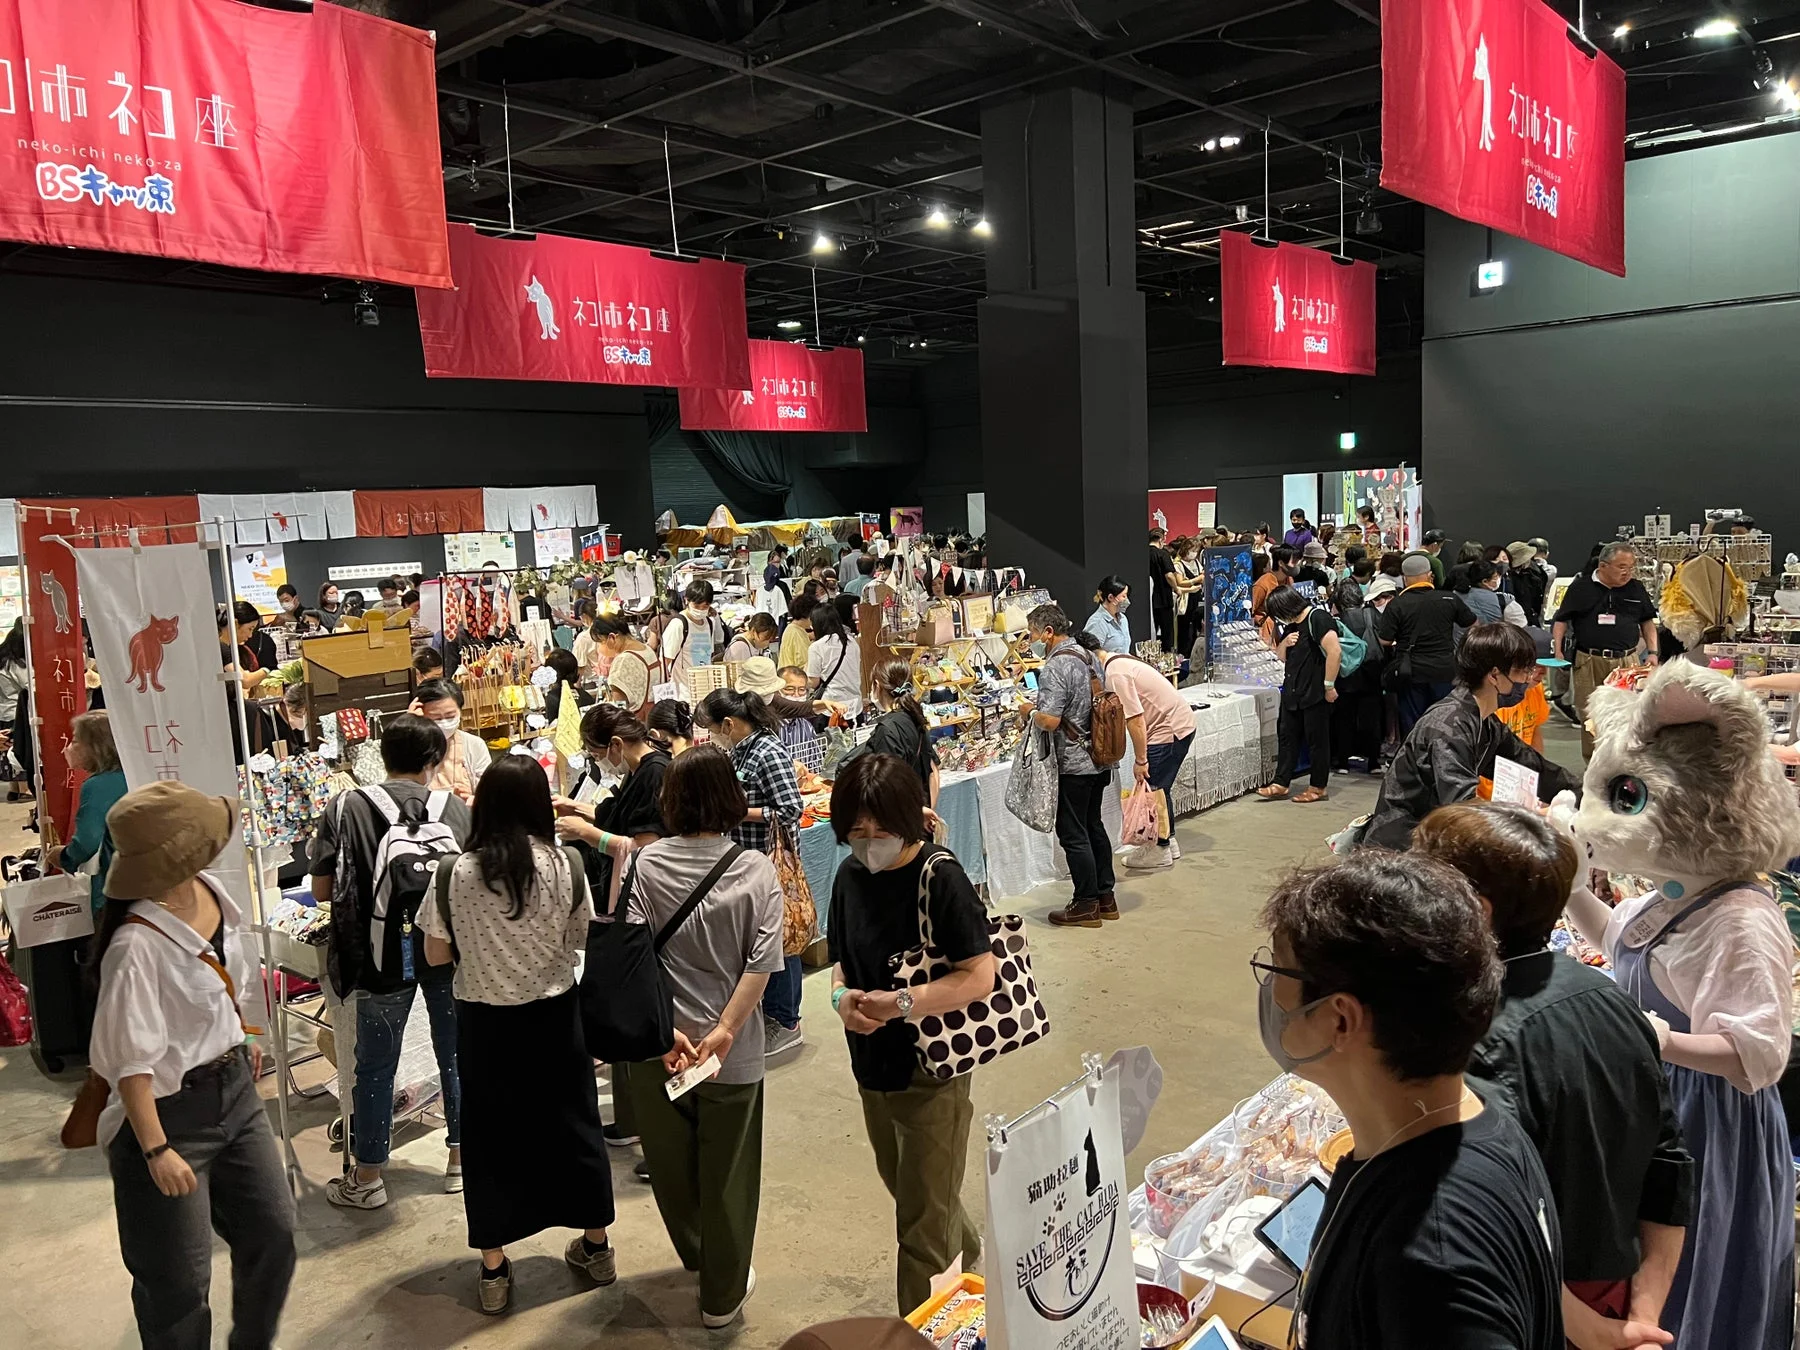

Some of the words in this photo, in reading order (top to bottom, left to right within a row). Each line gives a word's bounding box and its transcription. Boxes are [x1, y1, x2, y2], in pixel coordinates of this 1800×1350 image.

[17, 138, 106, 160] neko-ichi
[114, 151, 182, 172] neko-za
[1016, 1242, 1048, 1275] SAVE
[1053, 1221, 1072, 1246] THE
[1076, 1201, 1095, 1226] CAT
[1098, 1180, 1119, 1210] HIDA
